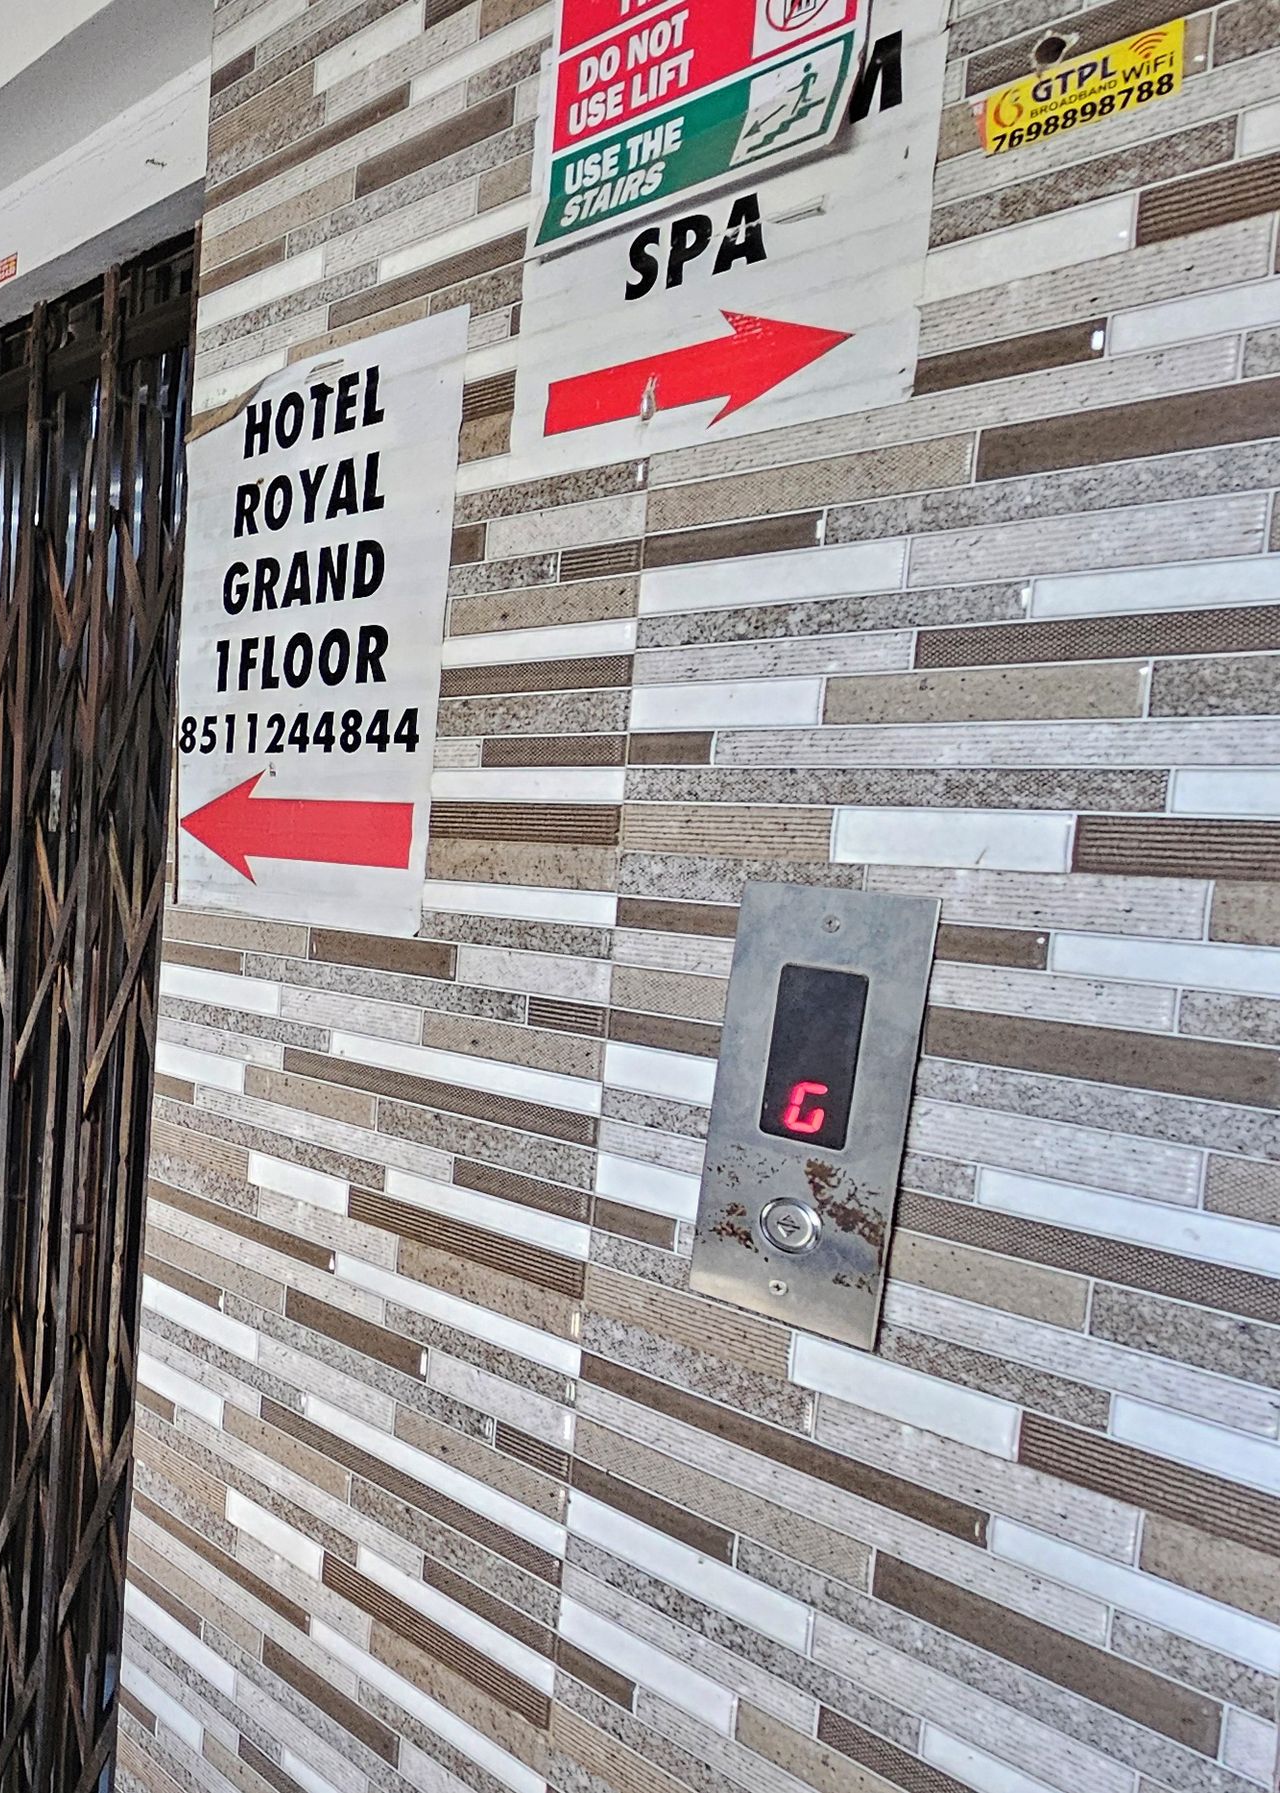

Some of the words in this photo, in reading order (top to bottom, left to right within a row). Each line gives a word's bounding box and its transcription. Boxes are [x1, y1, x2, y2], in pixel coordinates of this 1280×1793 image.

[569, 81, 625, 133] USE
[631, 49, 694, 109] LIFT
[579, 45, 621, 94] DO
[627, 9, 689, 71] NOT
[1030, 79, 1118, 118] BROADBAND
[1123, 51, 1176, 85] WiFi
[1031, 55, 1118, 103] GTPL
[991, 72, 1175, 154] 7698898788
[560, 161, 666, 228] STAIRS
[564, 148, 620, 194] USE
[627, 116, 685, 170] THE
[625, 192, 768, 301] SPA
[243, 364, 385, 461] HOTEL
[233, 452, 385, 538] ROYAL
[223, 539, 385, 616] GRAND
[179, 708, 420, 755] 8511244844
